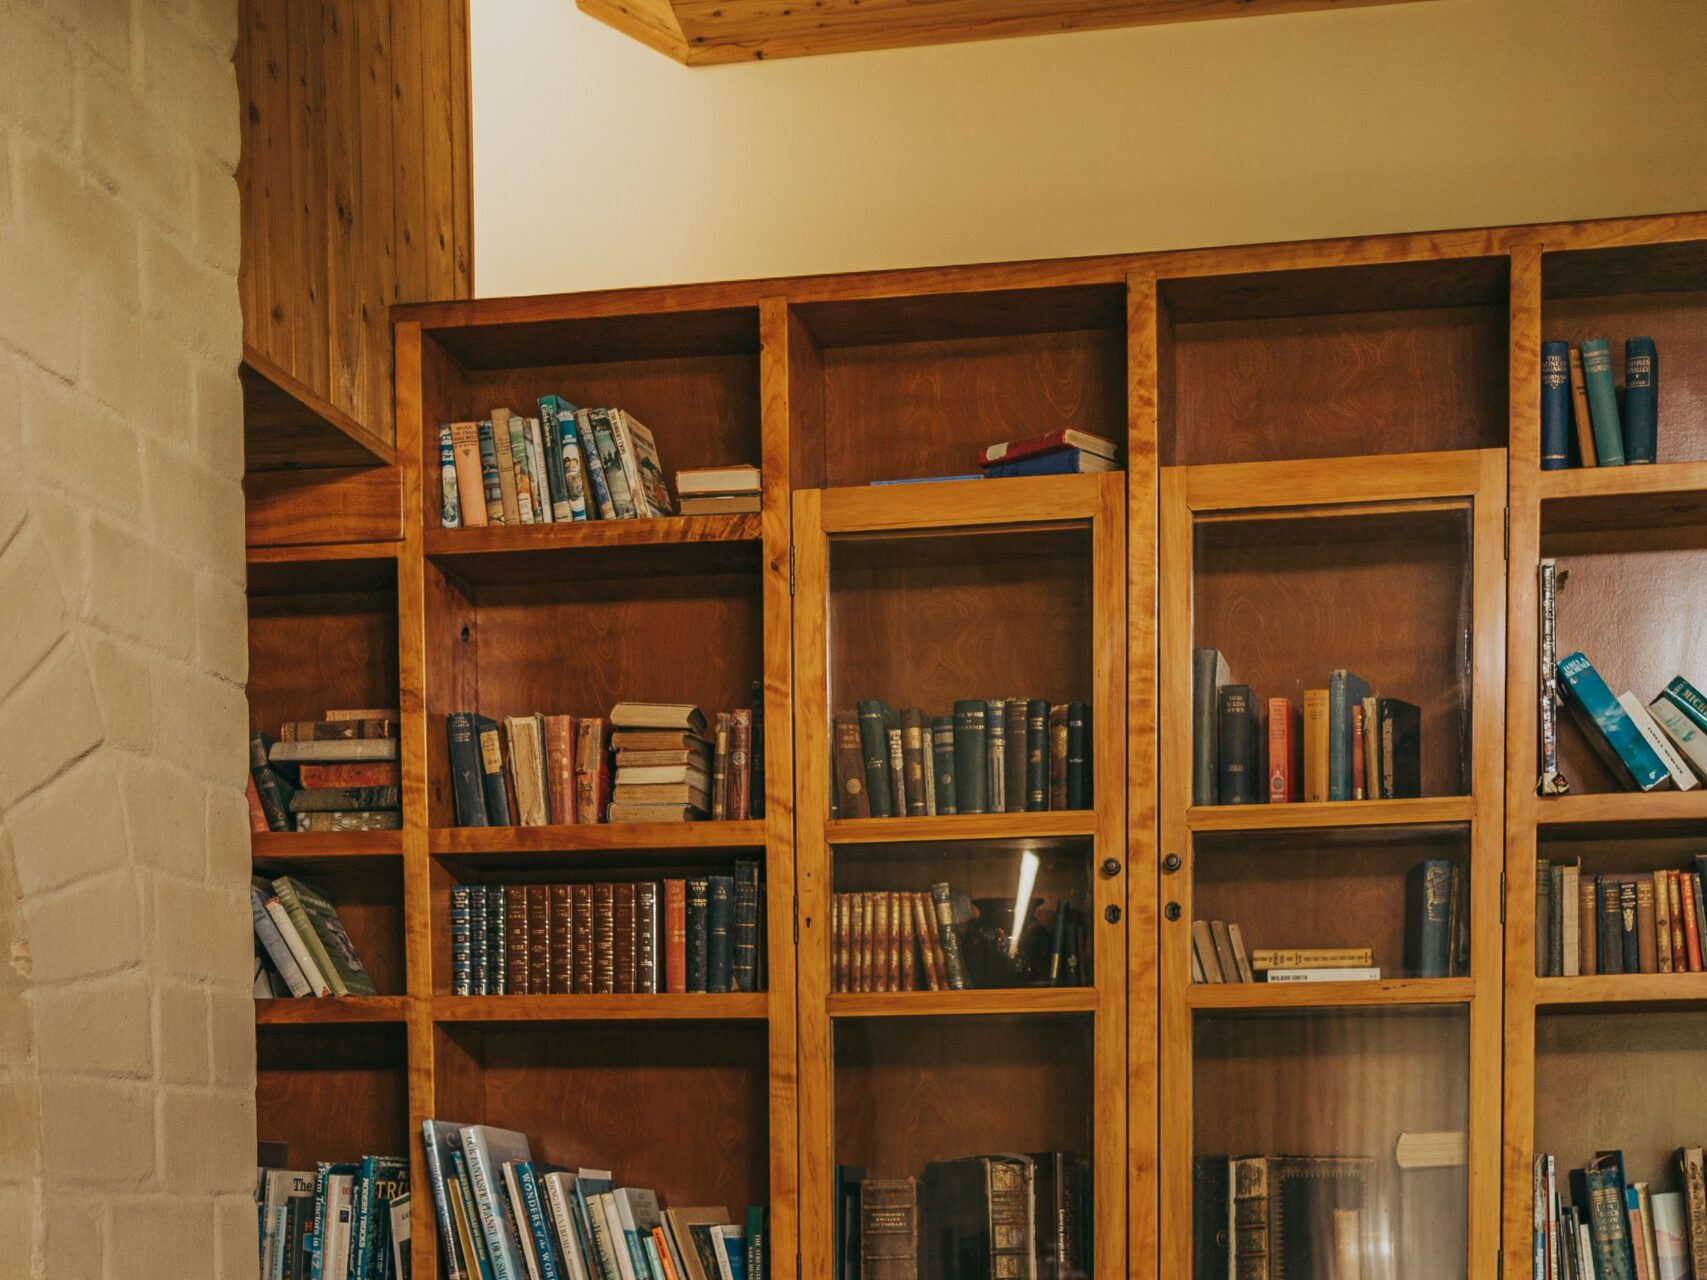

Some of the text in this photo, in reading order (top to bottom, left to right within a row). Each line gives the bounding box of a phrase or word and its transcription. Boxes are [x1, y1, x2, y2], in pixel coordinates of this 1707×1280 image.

[293, 1178, 312, 1192] The
[315, 1167, 324, 1193] Farm
[360, 1177, 369, 1214] MODERN
[312, 1195, 322, 1235] Tractors
[469, 1154, 489, 1203] FANTASTIC
[480, 1201, 497, 1238] PLANET
[489, 1239, 503, 1262] DICK
[521, 1171, 542, 1227] WONDERS
[358, 1214, 367, 1248] TRUCKS
[535, 1229, 544, 1238] of
[537, 1238, 547, 1250] the
[1695, 1239, 1705, 1271] HOME
